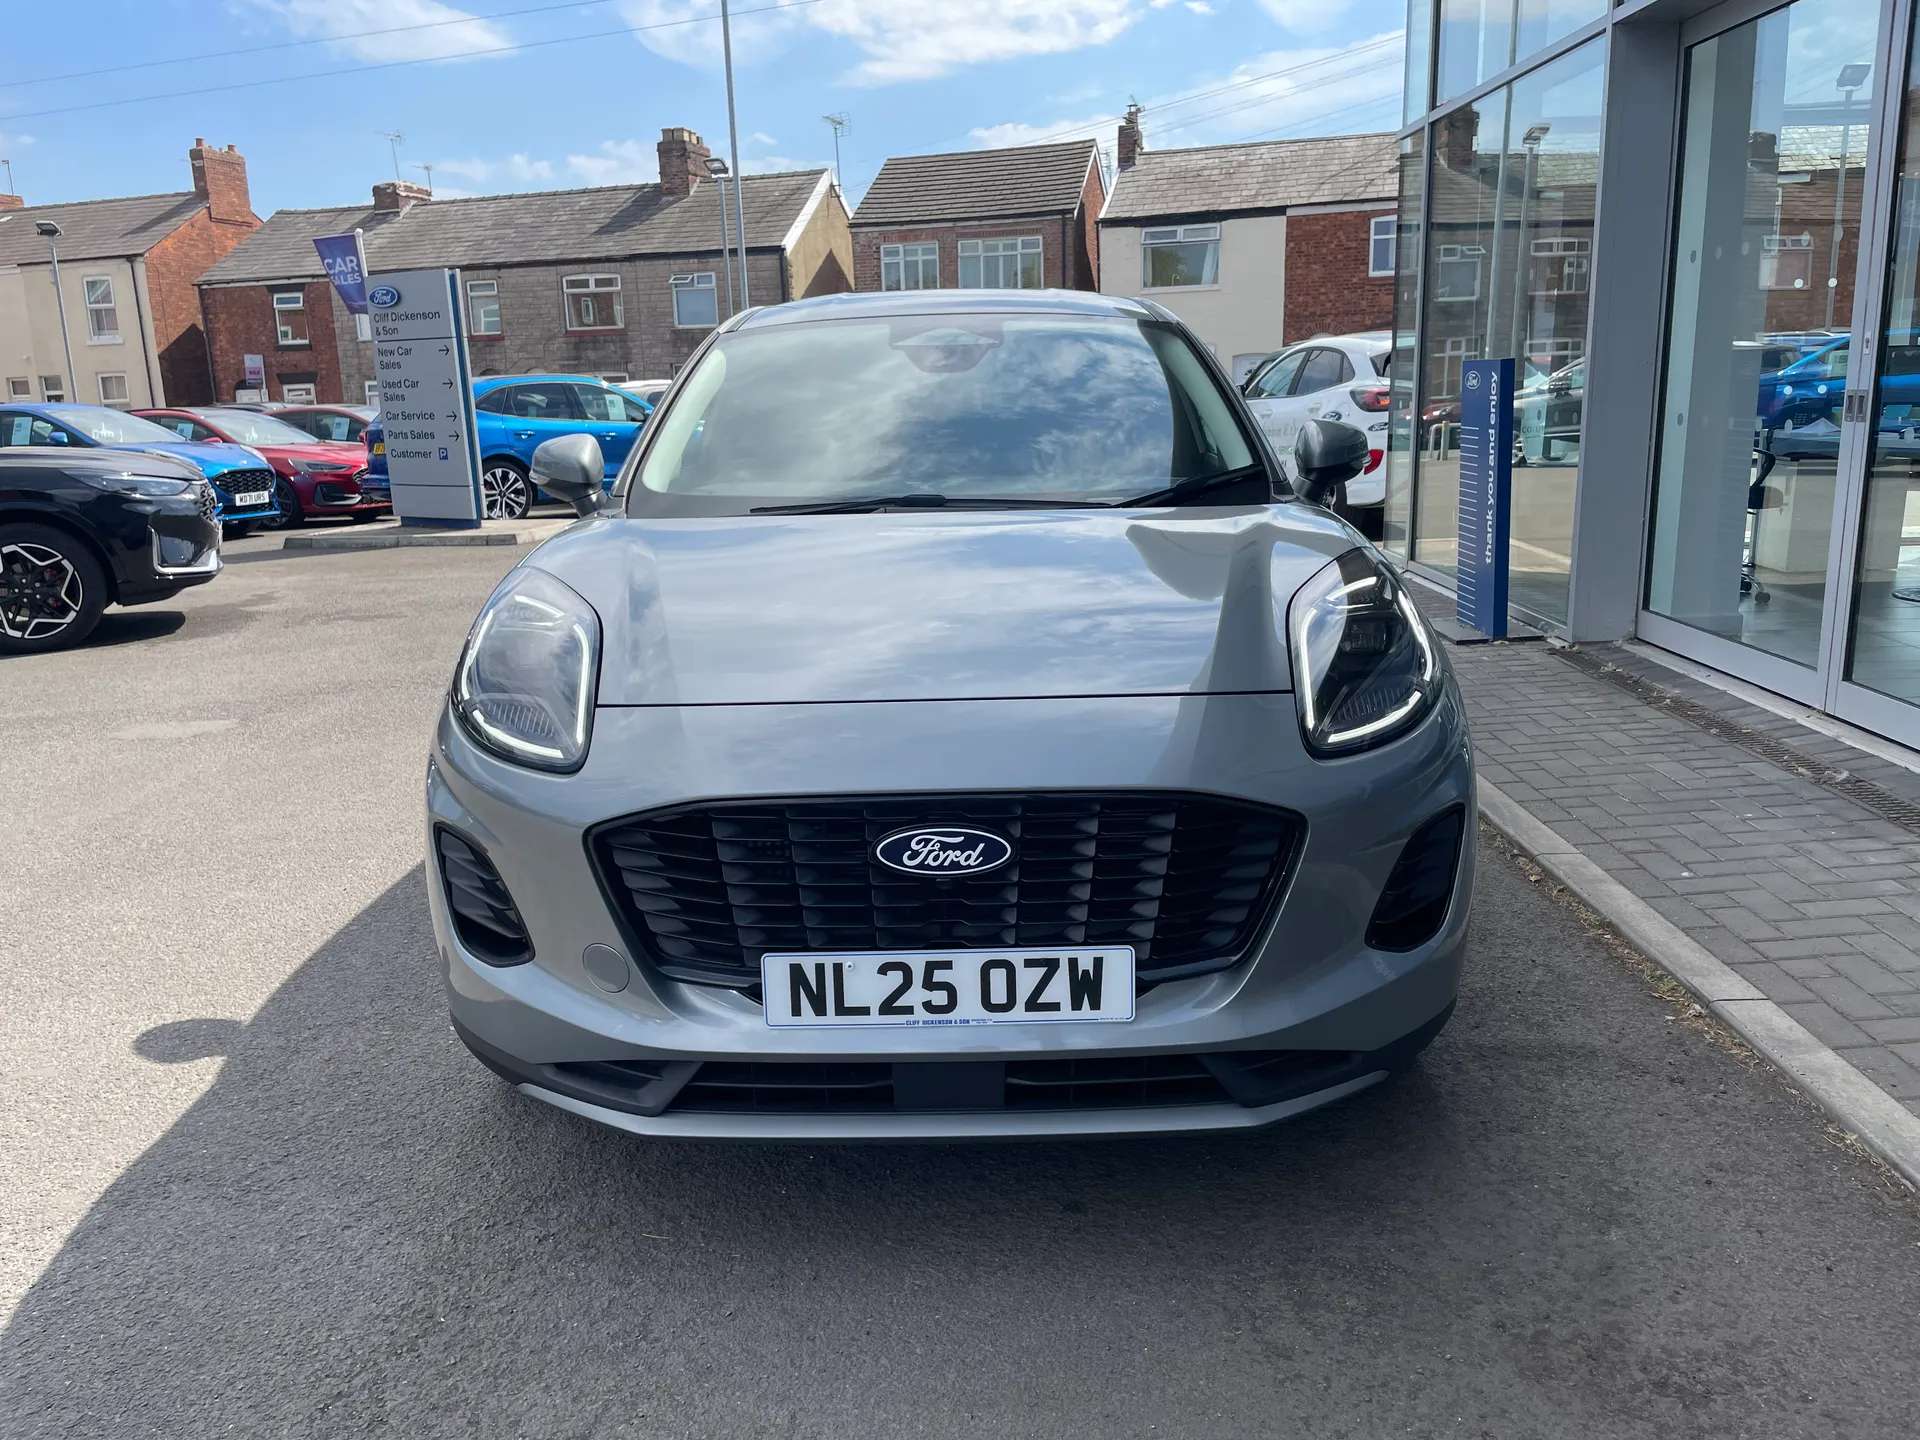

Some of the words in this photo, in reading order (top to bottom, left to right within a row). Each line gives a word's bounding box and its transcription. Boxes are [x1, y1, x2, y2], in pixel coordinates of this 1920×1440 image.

[324, 256, 358, 274] CAR
[374, 312, 389, 323] Cliff
[391, 311, 441, 322] Dickenson
[382, 326, 399, 336] Son
[377, 347, 395, 357] New
[397, 346, 412, 357] Car
[379, 360, 402, 370] Sales
[381, 379, 402, 389] Used
[403, 378, 420, 389] Car
[383, 392, 406, 402] Sales
[1489, 371, 1498, 426] enjoy
[385, 410, 400, 421] Car
[401, 410, 436, 421] Service
[388, 430, 409, 440] Parts
[410, 430, 436, 440] Sales
[1488, 428, 1496, 467] and
[390, 448, 432, 459] Customer
[1487, 470, 1495, 506] you
[1485, 509, 1493, 565] thank
[788, 960, 958, 1017] NL25
[980, 956, 1104, 1014] OZW
